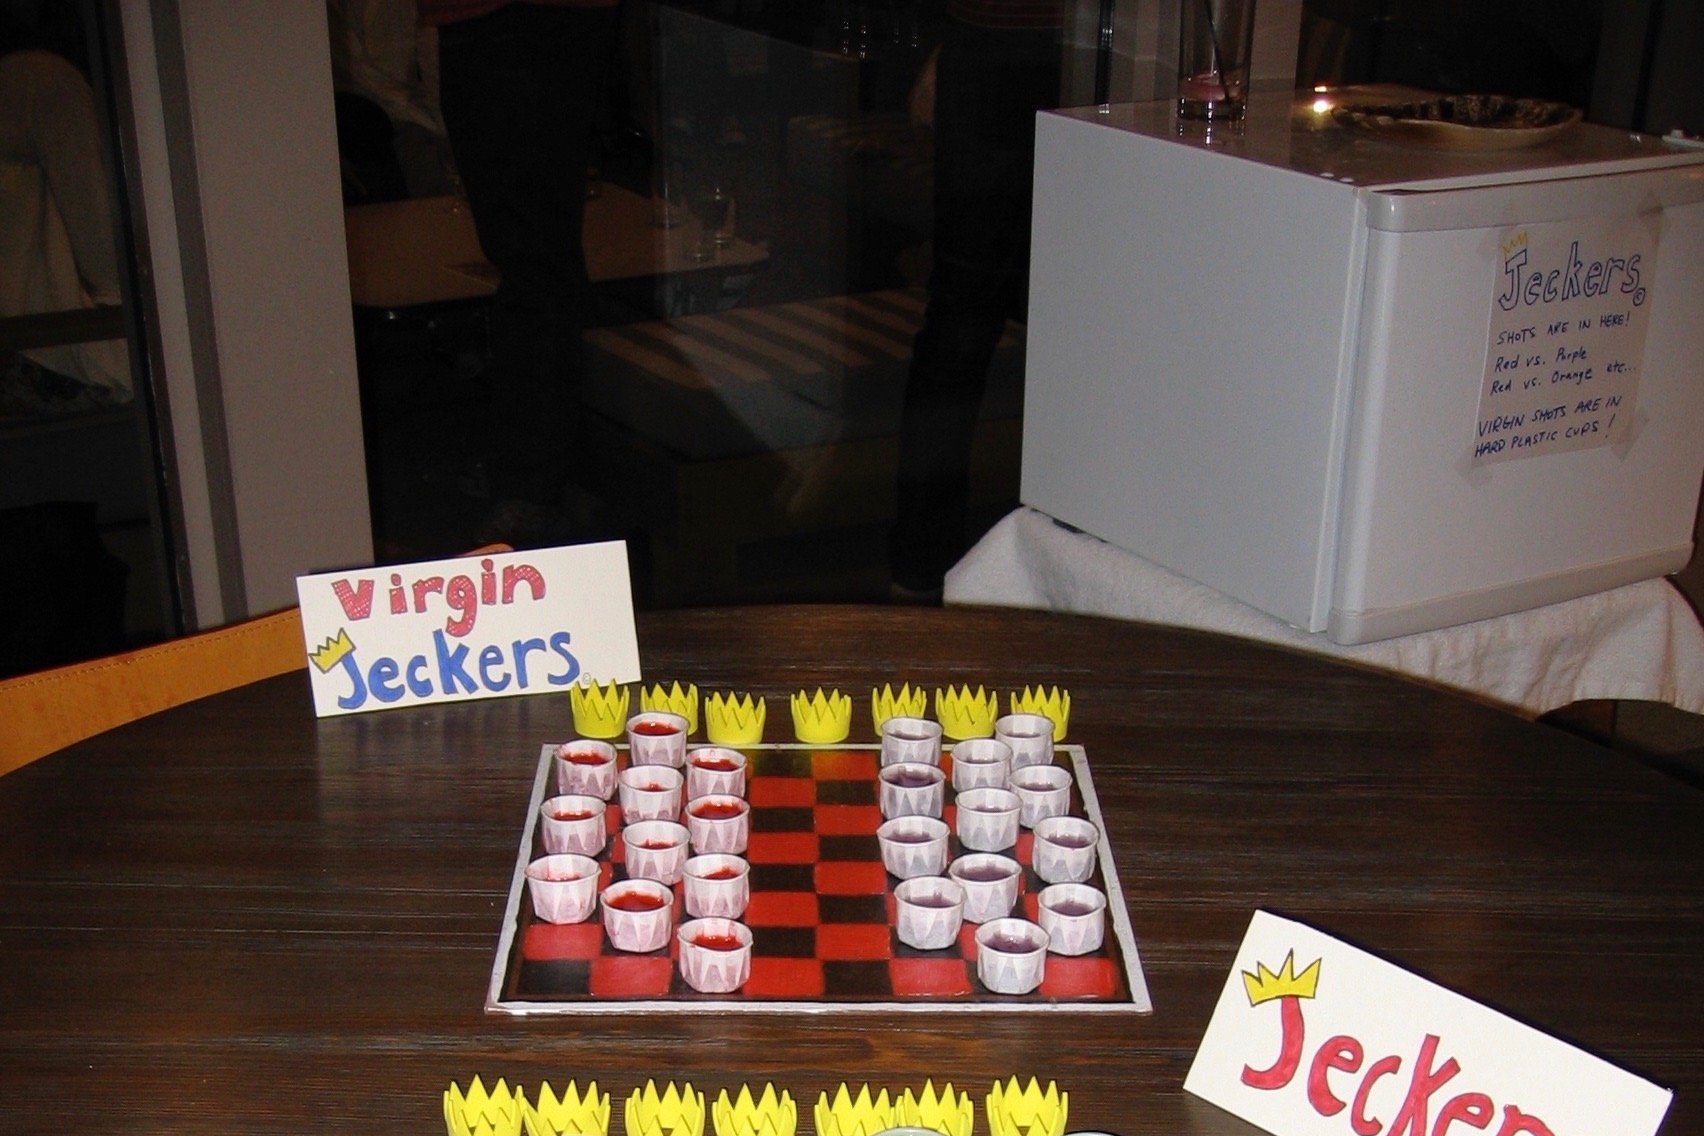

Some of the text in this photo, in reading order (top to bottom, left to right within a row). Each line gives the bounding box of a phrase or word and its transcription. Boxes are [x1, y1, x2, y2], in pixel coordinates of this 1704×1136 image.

[1498, 241, 1641, 311] Jeckers
[1497, 311, 1631, 345] SHOTS ARE IN HERE!
[1495, 346, 1588, 373] Red vs. Purple
[1490, 379, 1512, 396] Red
[1523, 377, 1541, 389] vs.
[1551, 368, 1592, 386] Orange
[1478, 396, 1622, 437] VIRGIN SHOTS ARE IN
[1474, 438, 1506, 458] HARD
[1511, 431, 1558, 449] PLASTIC
[331, 558, 545, 637] Virgin
[337, 629, 580, 709] Jeckers
